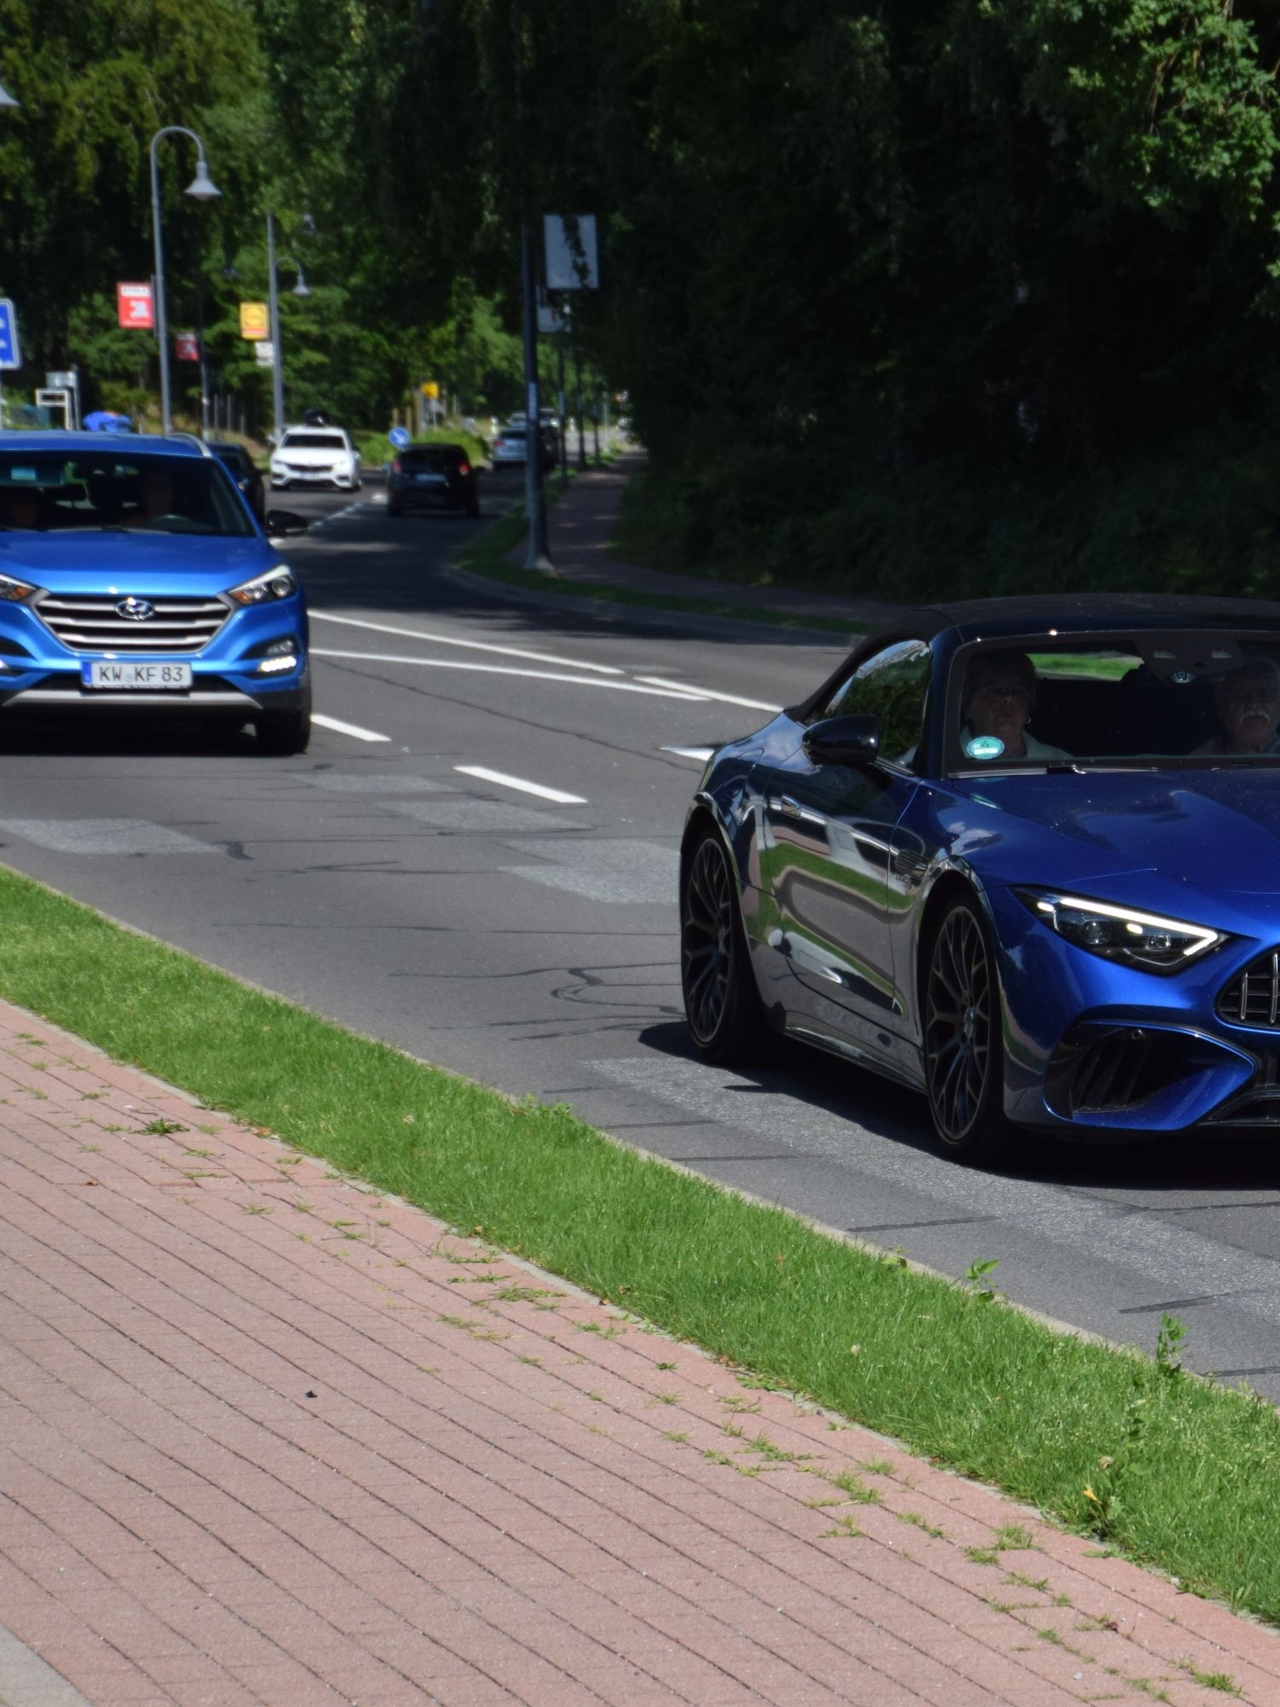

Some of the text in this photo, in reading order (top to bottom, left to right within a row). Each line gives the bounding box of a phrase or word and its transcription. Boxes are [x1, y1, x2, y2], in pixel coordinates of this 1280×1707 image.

[99, 666, 183, 682] KW KF 83
